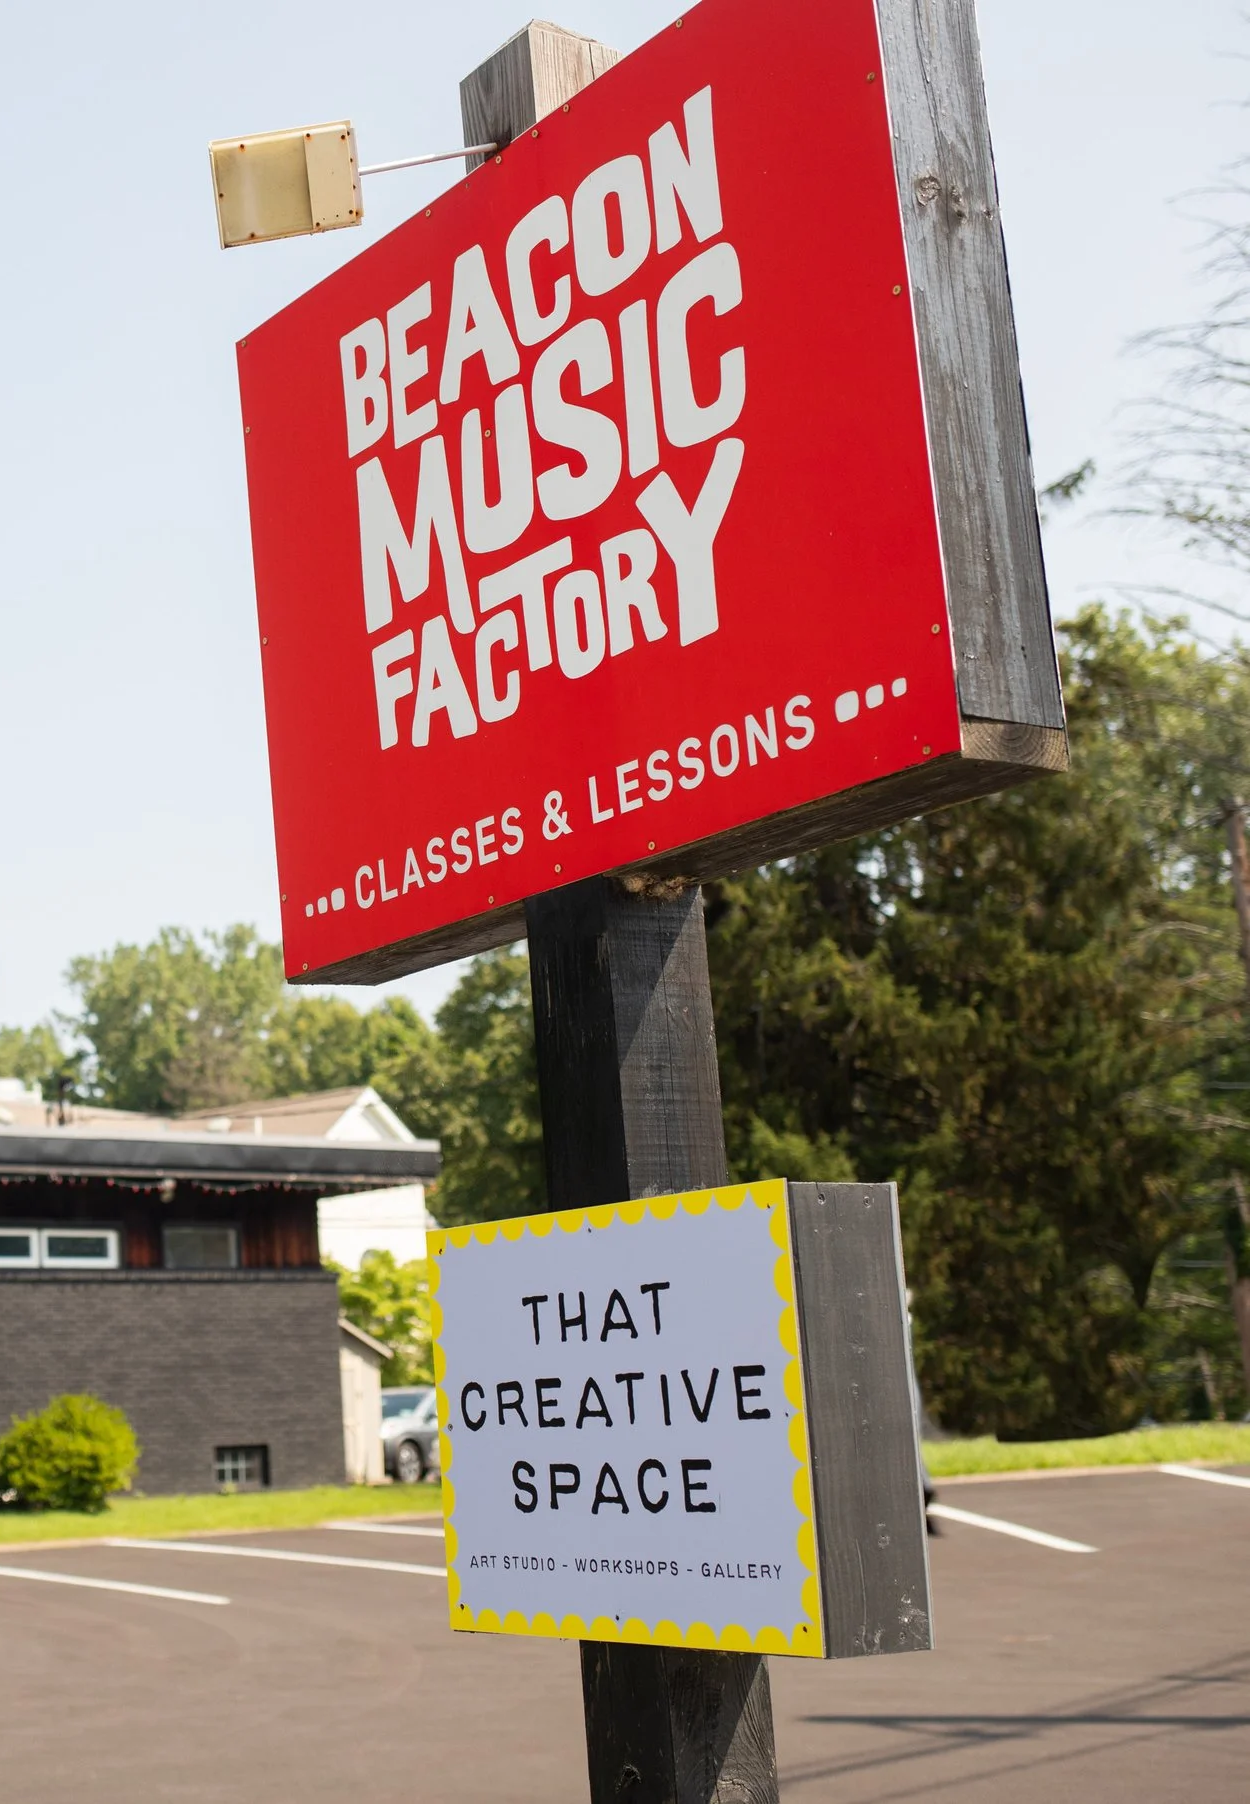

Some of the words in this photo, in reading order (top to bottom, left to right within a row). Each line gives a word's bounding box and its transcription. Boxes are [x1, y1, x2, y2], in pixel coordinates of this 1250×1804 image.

[339, 84, 724, 459] BEACON
[355, 241, 747, 635] MUSIC
[371, 437, 745, 751] FACTORY
[354, 807, 524, 909] CLASSES
[541, 790, 574, 841] &
[588, 694, 815, 824] LESSONS
[521, 1281, 671, 1346] THAT
[460, 1364, 771, 1432] CREATIVE
[511, 1458, 717, 1515] SPACE
[470, 1555, 497, 1569] ART
[503, 1555, 555, 1572] STUDIO
[574, 1558, 679, 1576] WORKSHOPS
[701, 1562, 782, 1580] GALLERY
